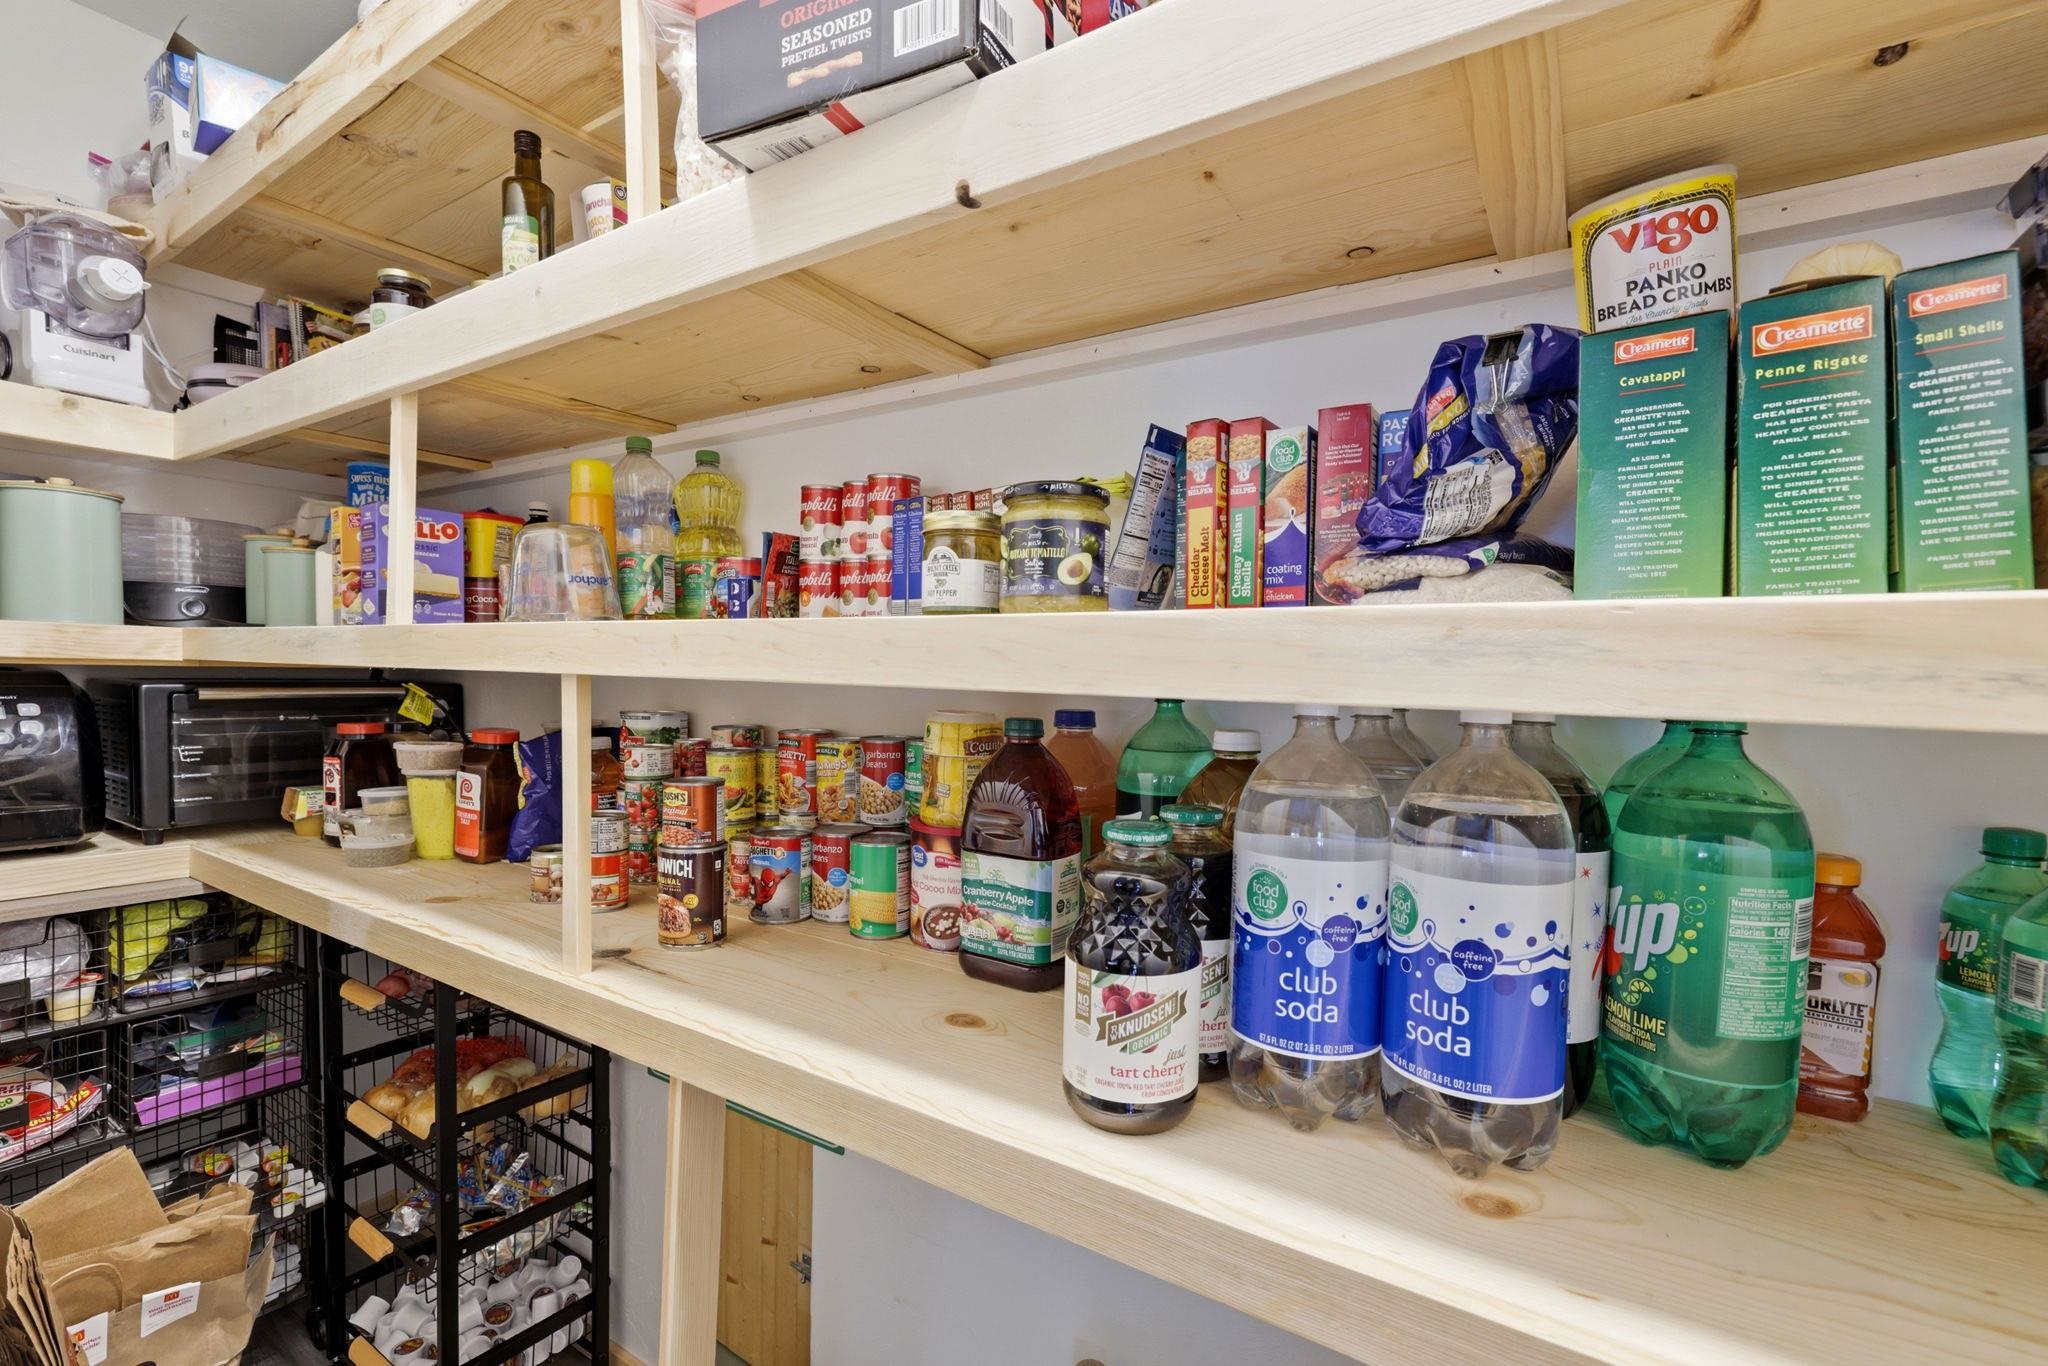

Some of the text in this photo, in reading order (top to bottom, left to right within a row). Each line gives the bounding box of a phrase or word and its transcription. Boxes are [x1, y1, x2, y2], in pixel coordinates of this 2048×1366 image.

[781, 8, 872, 53] SEASONED
[781, 28, 872, 68] PRETZEL TWISTS
[1649, 256, 1682, 272] PLAIN
[1626, 263, 1706, 297] PANKO
[1598, 276, 1731, 322] BREAD CRUMBS
[1757, 315, 1866, 350] Creamette
[1915, 320, 2004, 344] Small Shells
[63, 343, 117, 363] Cuisinart
[1617, 334, 1689, 359] Creamette
[1756, 353, 1869, 380] Penne Rigate
[1620, 368, 1685, 387] Cavatappi
[1836, 399, 1872, 408] PASTA
[1382, 417, 1410, 432] PAS
[1790, 416, 1817, 424] BEEN
[1755, 429, 1789, 439] HEART
[1808, 419, 1870, 431] COUNTLESS
[1773, 436, 1809, 445] FAMILY
[1275, 445, 1295, 456] food
[1275, 454, 1294, 463] club
[1798, 450, 1825, 458] LONG
[1761, 455, 1864, 472] FAMILIES CONTINUE
[1777, 470, 1817, 480] GATHER
[1821, 465, 1864, 475] AROUND
[1050, 483, 1068, 491] MILD
[1761, 483, 1781, 491] THE
[1785, 479, 1823, 488] DINNER
[1774, 485, 1850, 498] CREAMETTE
[867, 486, 895, 502] pbell's
[952, 494, 966, 503] RICE
[800, 496, 837, 515] mpbell's
[415, 543, 438, 552] assic
[1232, 513, 1243, 598] Cheesy Italian
[1200, 526, 1209, 597] Cheese Melt
[1267, 563, 1302, 576] coating
[800, 571, 832, 588] mpbell's
[1191, 547, 1200, 597] Cheddar
[1242, 561, 1252, 597] Shells
[1265, 575, 1284, 585] mix
[473, 595, 498, 603] Cocoa
[1266, 593, 1295, 601] chicken
[866, 750, 900, 760] garbanzo
[866, 760, 888, 768] beans
[659, 859, 693, 879] NWICH
[919, 883, 944, 893] Cocoa
[963, 885, 1034, 906] Cranberry Apple
[1253, 880, 1279, 897] food
[975, 898, 1017, 911] Juice Cocktail
[1253, 894, 1277, 910] club
[1392, 892, 1411, 913] food
[1731, 900, 1792, 910] Nutrition Facts
[1392, 909, 1409, 925] club
[1323, 923, 1355, 934] caffeine
[1729, 927, 1789, 937] Calories 140
[1332, 934, 1348, 943] free
[1454, 951, 1493, 963] caffeine
[1463, 961, 1483, 970] free
[1279, 966, 1337, 995] club
[1960, 967, 1990, 981] LEMON
[1077, 993, 1089, 1006] NO
[1410, 989, 1470, 1025] club
[1807, 995, 1865, 1018] ORLYTE
[1275, 997, 1338, 1023] soda
[1605, 994, 1631, 1023] LEMON
[1634, 1011, 1666, 1036] LIME
[1117, 1005, 1173, 1037] KNUDSEN
[1201, 1020, 1227, 1031] herr
[1131, 1027, 1169, 1050] ORGANIC
[1406, 1020, 1470, 1056] soda
[1632, 1025, 1651, 1041] SODA
[1272, 1037, 1278, 1045] FL
[1315, 1044, 1322, 1054] FL
[1340, 1045, 1353, 1053] LITER
[1164, 1046, 1186, 1066] just
[1110, 1062, 1185, 1079] tart cherry
[1444, 1077, 1451, 1087] FL
[1466, 1082, 1471, 1091] 2
[1473, 1084, 1492, 1094] LITER
